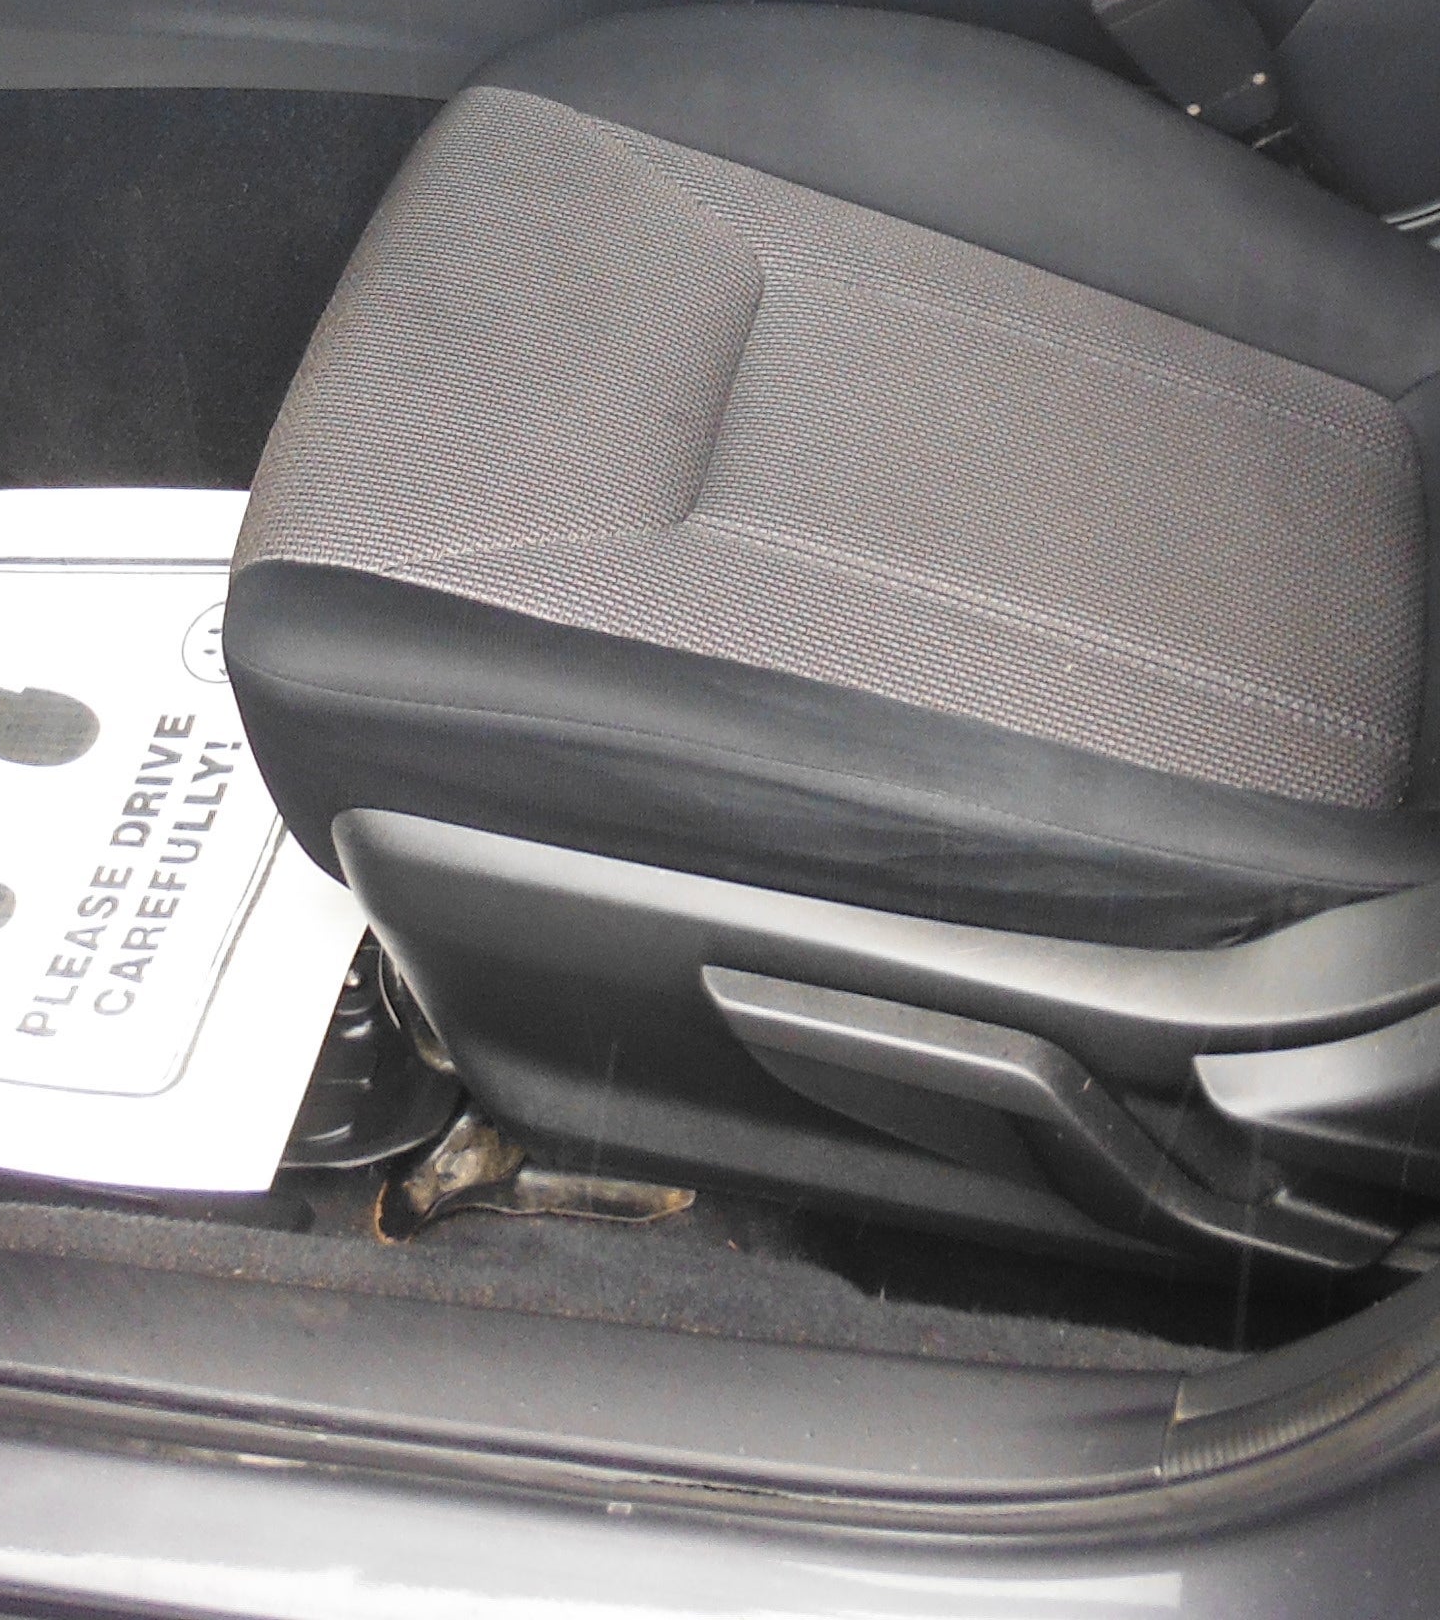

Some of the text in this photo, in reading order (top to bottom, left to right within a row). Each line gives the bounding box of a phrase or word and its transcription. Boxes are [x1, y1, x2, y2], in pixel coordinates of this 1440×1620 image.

[16, 714, 196, 1037] PLEASE DRIVE
[93, 741, 242, 1016] CAREFULLY!
